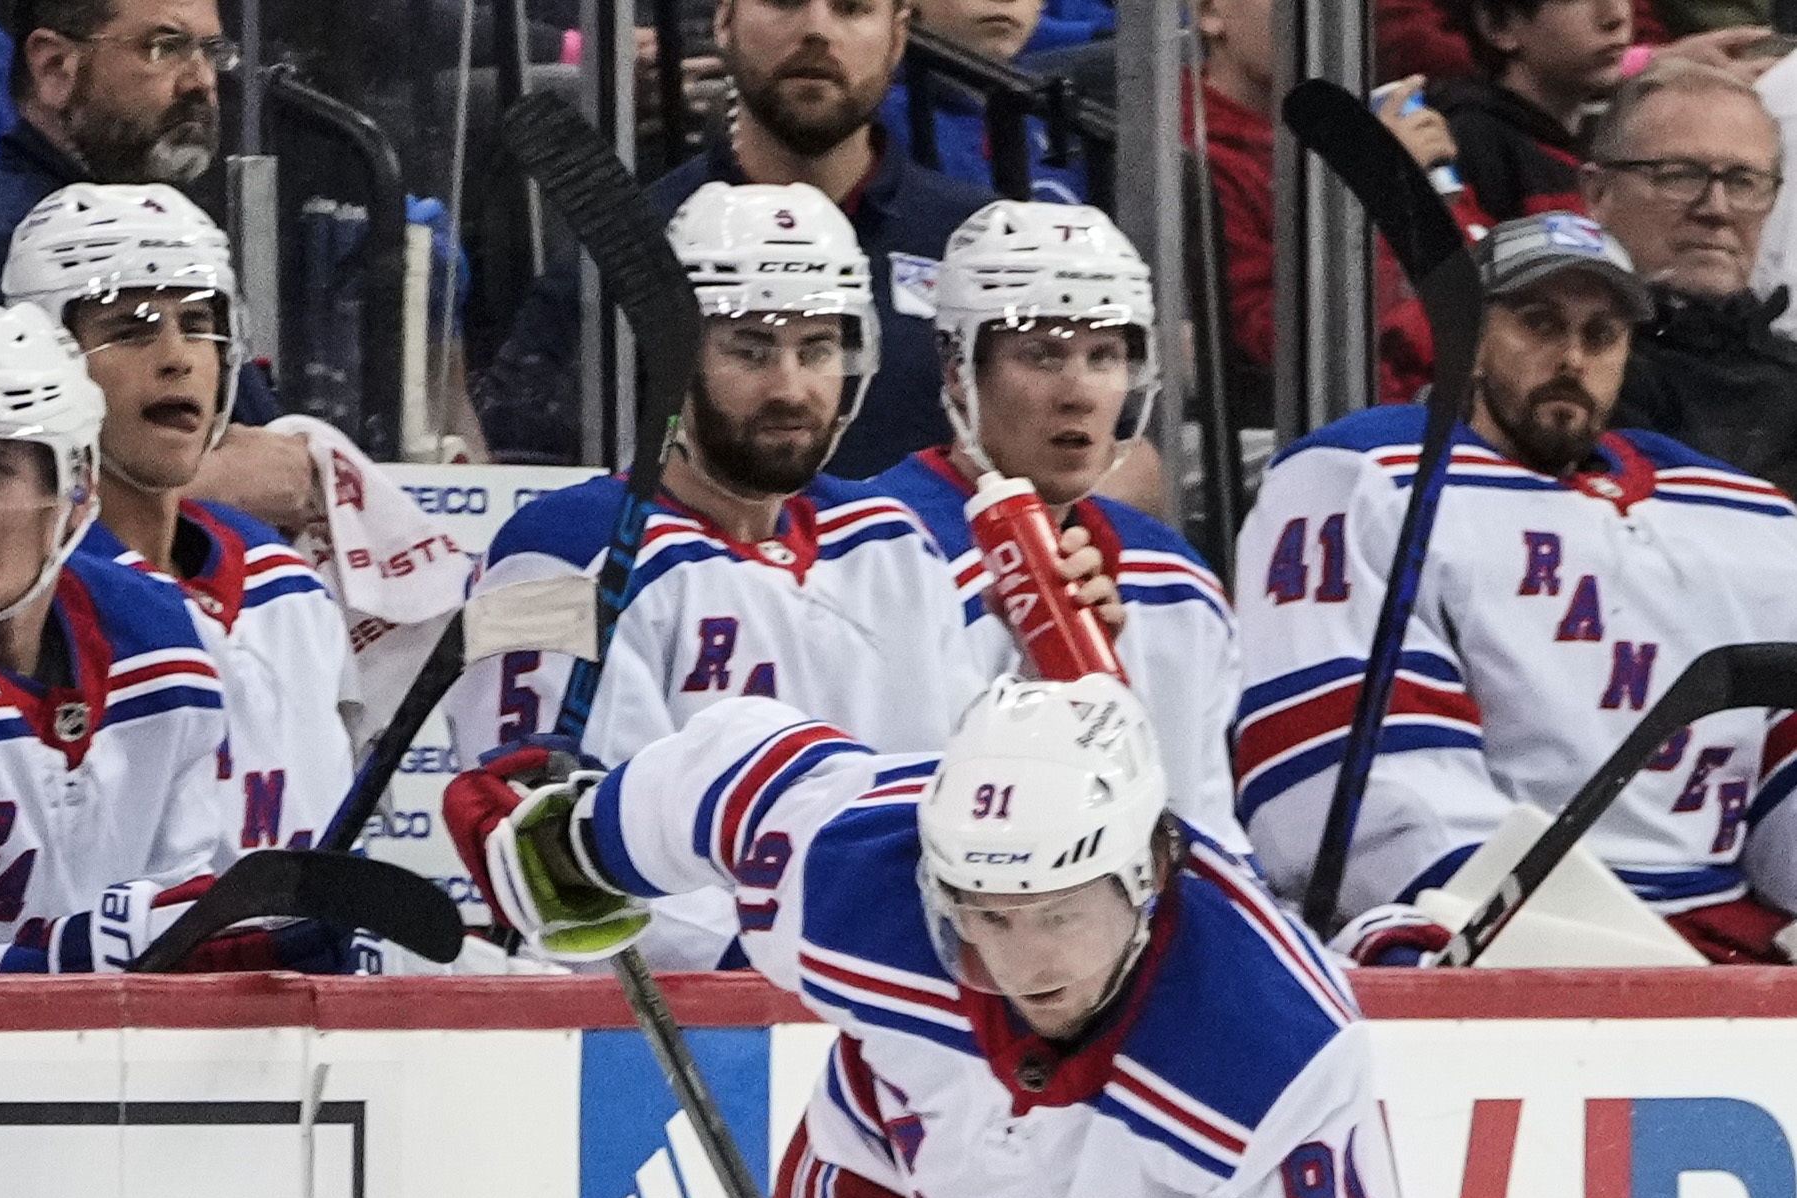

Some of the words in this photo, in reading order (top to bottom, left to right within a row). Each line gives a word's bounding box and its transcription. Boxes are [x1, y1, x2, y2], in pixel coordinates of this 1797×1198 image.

[1266, 513, 1352, 606] 41
[972, 784, 1015, 819] 91
[964, 851, 1033, 865] CCM
